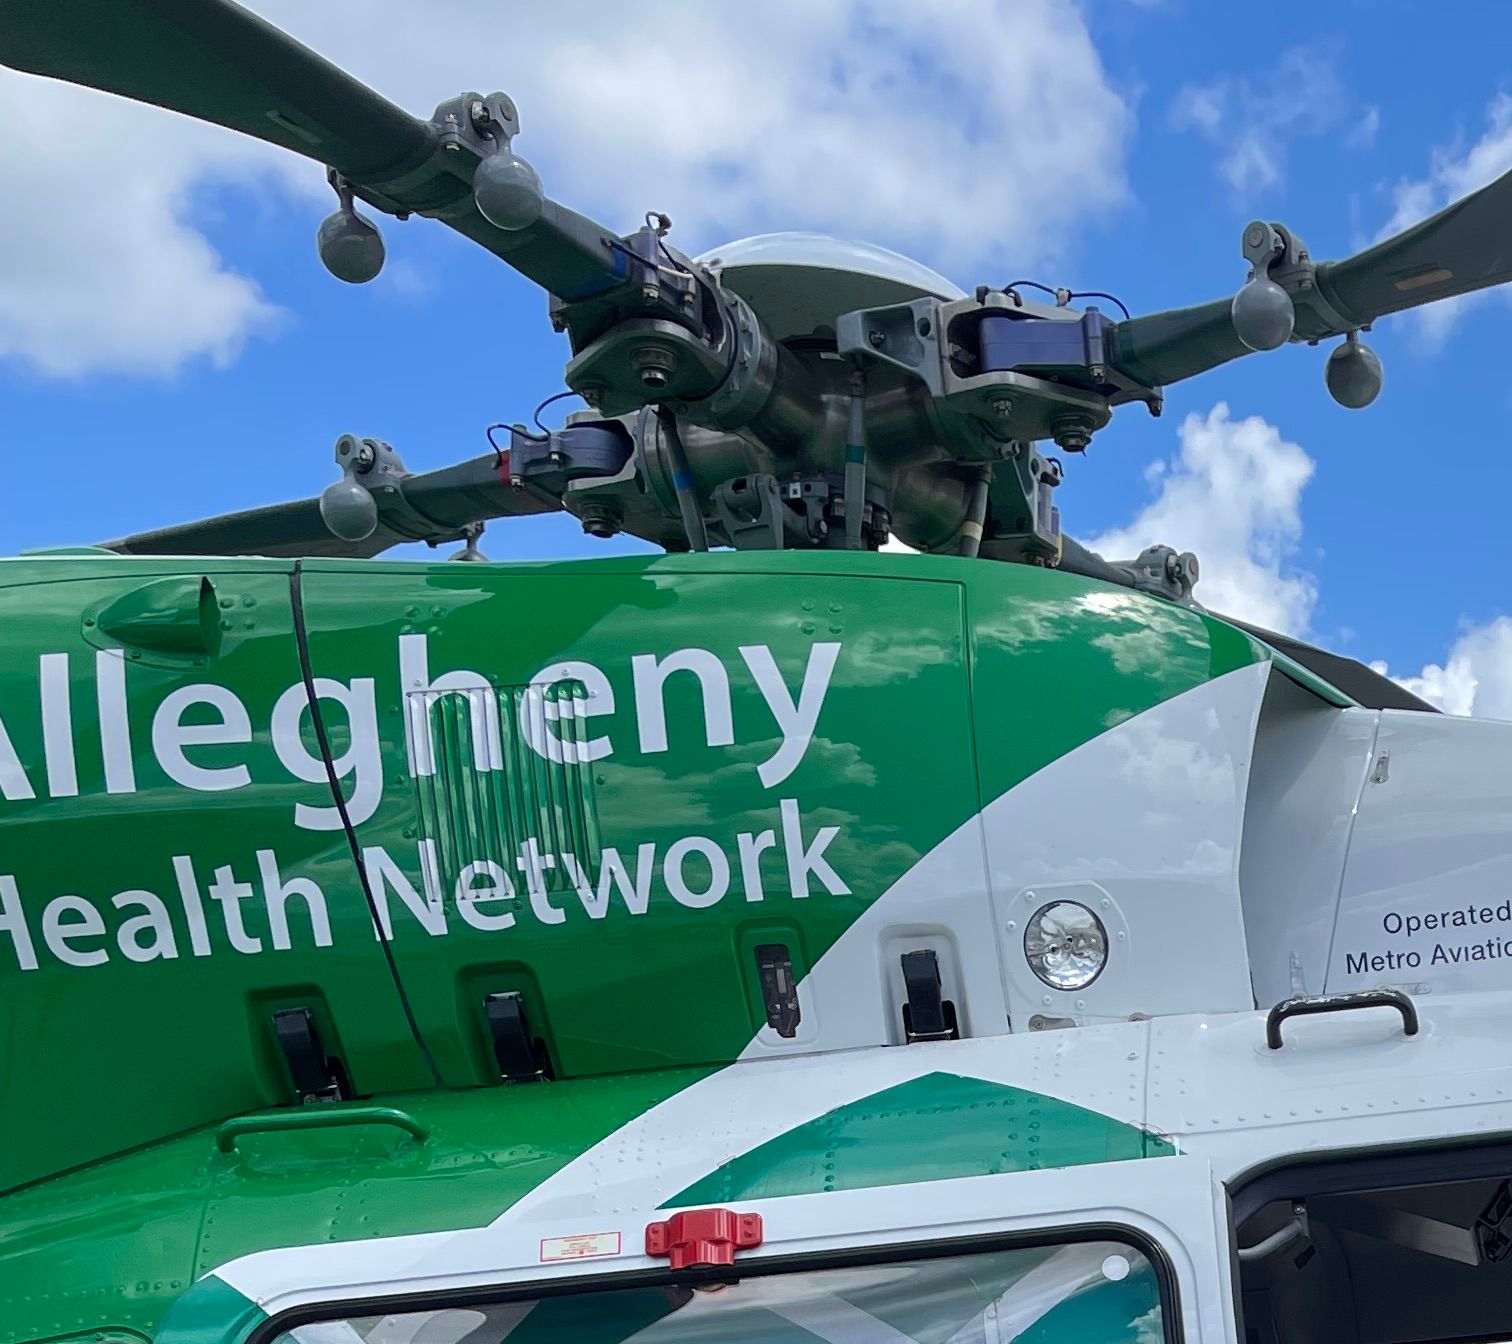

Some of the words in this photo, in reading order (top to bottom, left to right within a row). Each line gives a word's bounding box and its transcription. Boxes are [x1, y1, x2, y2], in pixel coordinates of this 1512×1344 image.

[358, 798, 852, 943] Network
[1382, 900, 1512, 936] Operated
[1346, 950, 1422, 975] Metro
